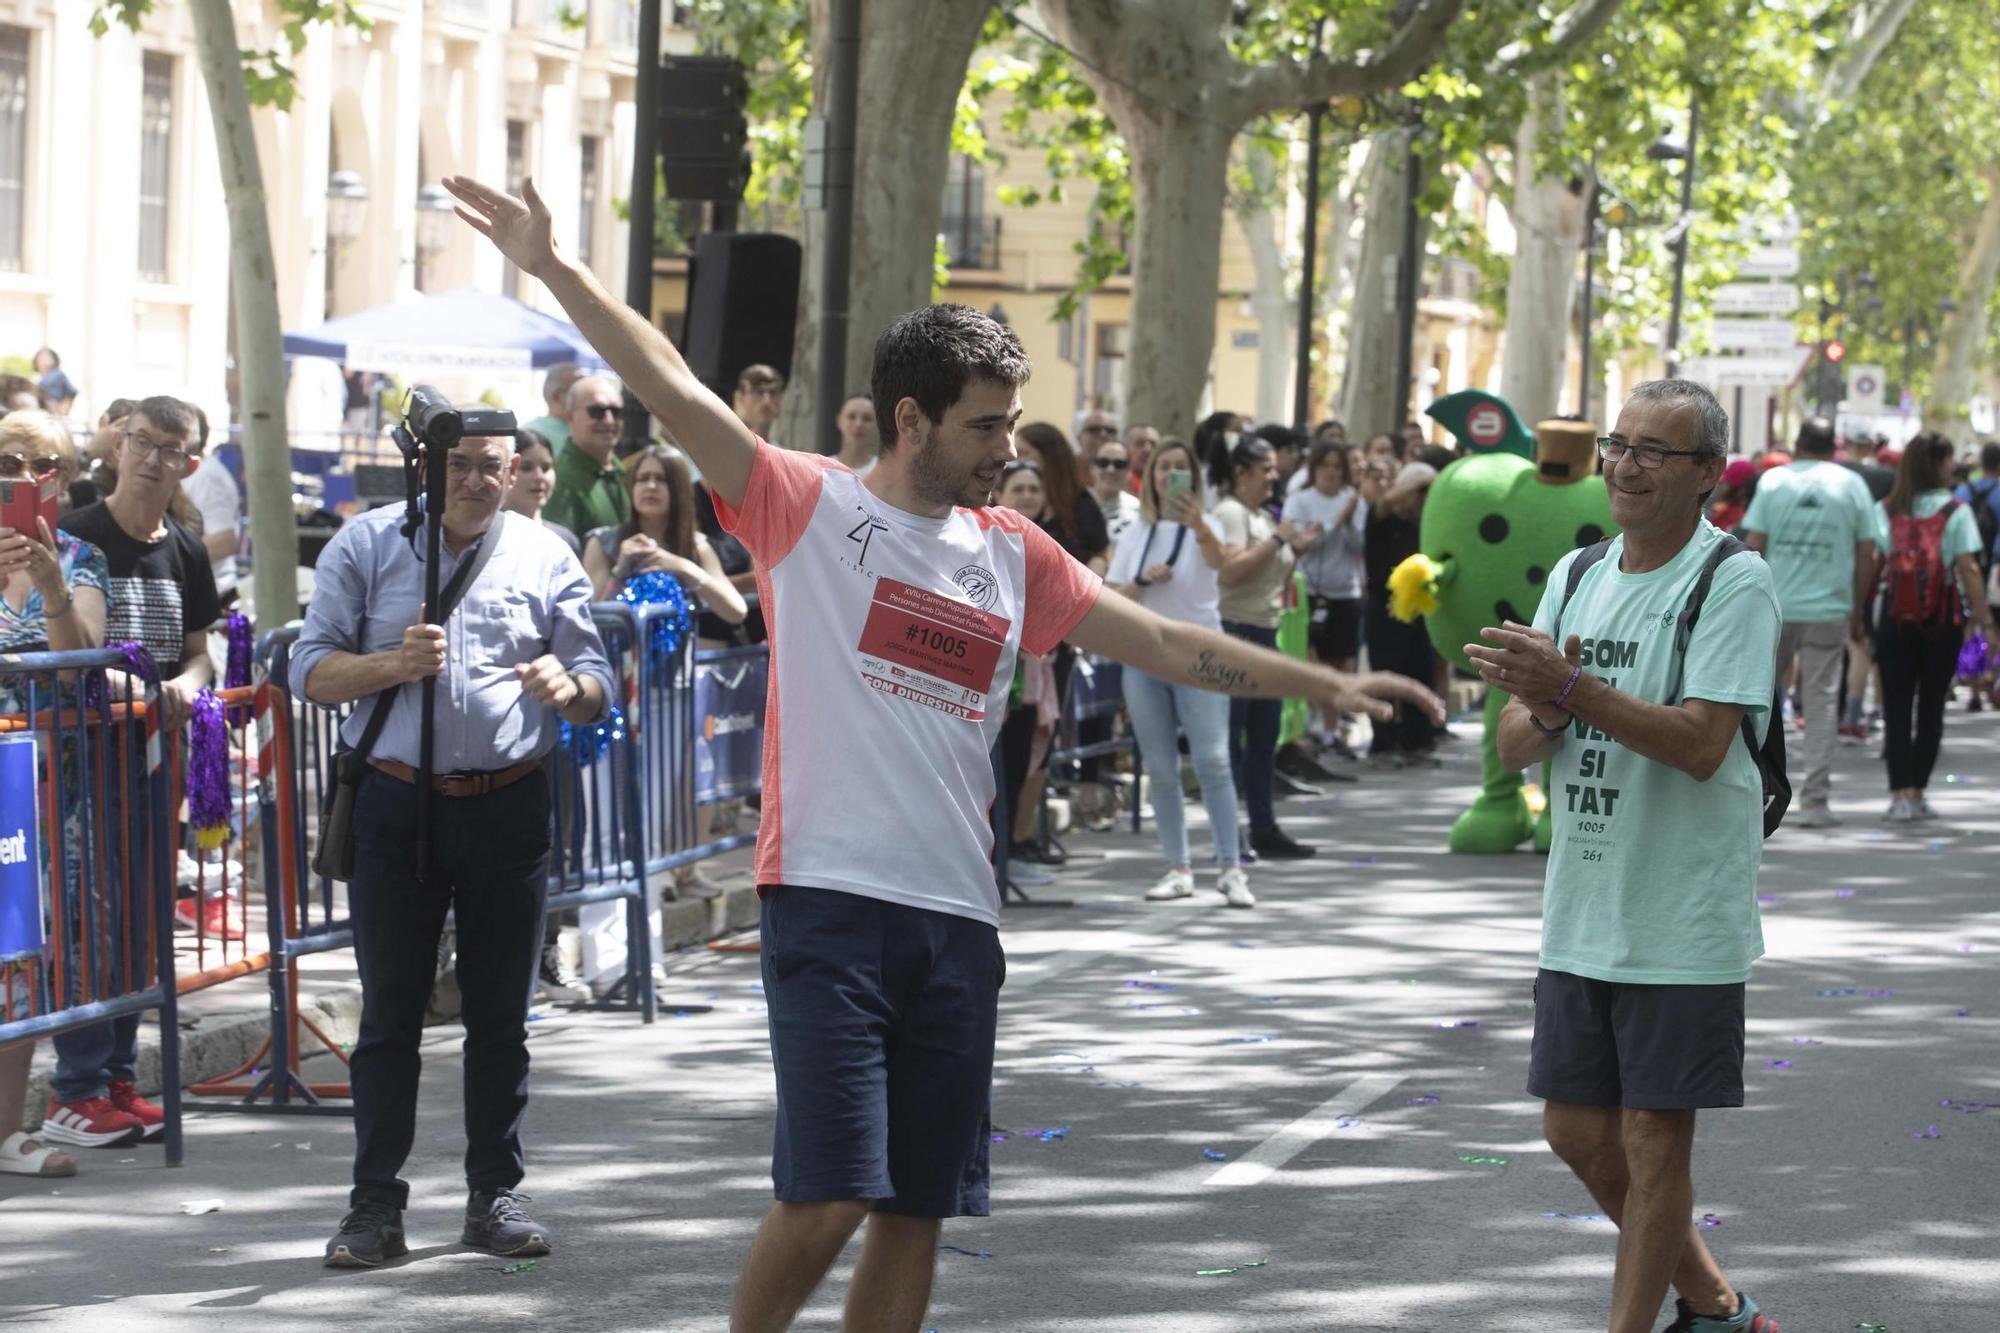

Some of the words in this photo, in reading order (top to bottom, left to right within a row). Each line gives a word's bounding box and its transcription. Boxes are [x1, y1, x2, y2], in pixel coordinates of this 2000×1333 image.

[890, 593, 920, 609] Persones
[920, 604, 934, 614] amb
[934, 607, 966, 625] Diversitat
[922, 593, 946, 607] Carrera
[947, 602, 972, 617] Popular
[972, 611, 984, 621] per
[905, 623, 969, 658] #1005
[1580, 638, 1639, 668] SOM
[896, 684, 970, 719] DIVERSITAT
[1579, 748, 1606, 779] SI
[1565, 783, 1620, 816] TAT
[1577, 821, 1605, 834] 1005
[1582, 850, 1602, 862] 261
